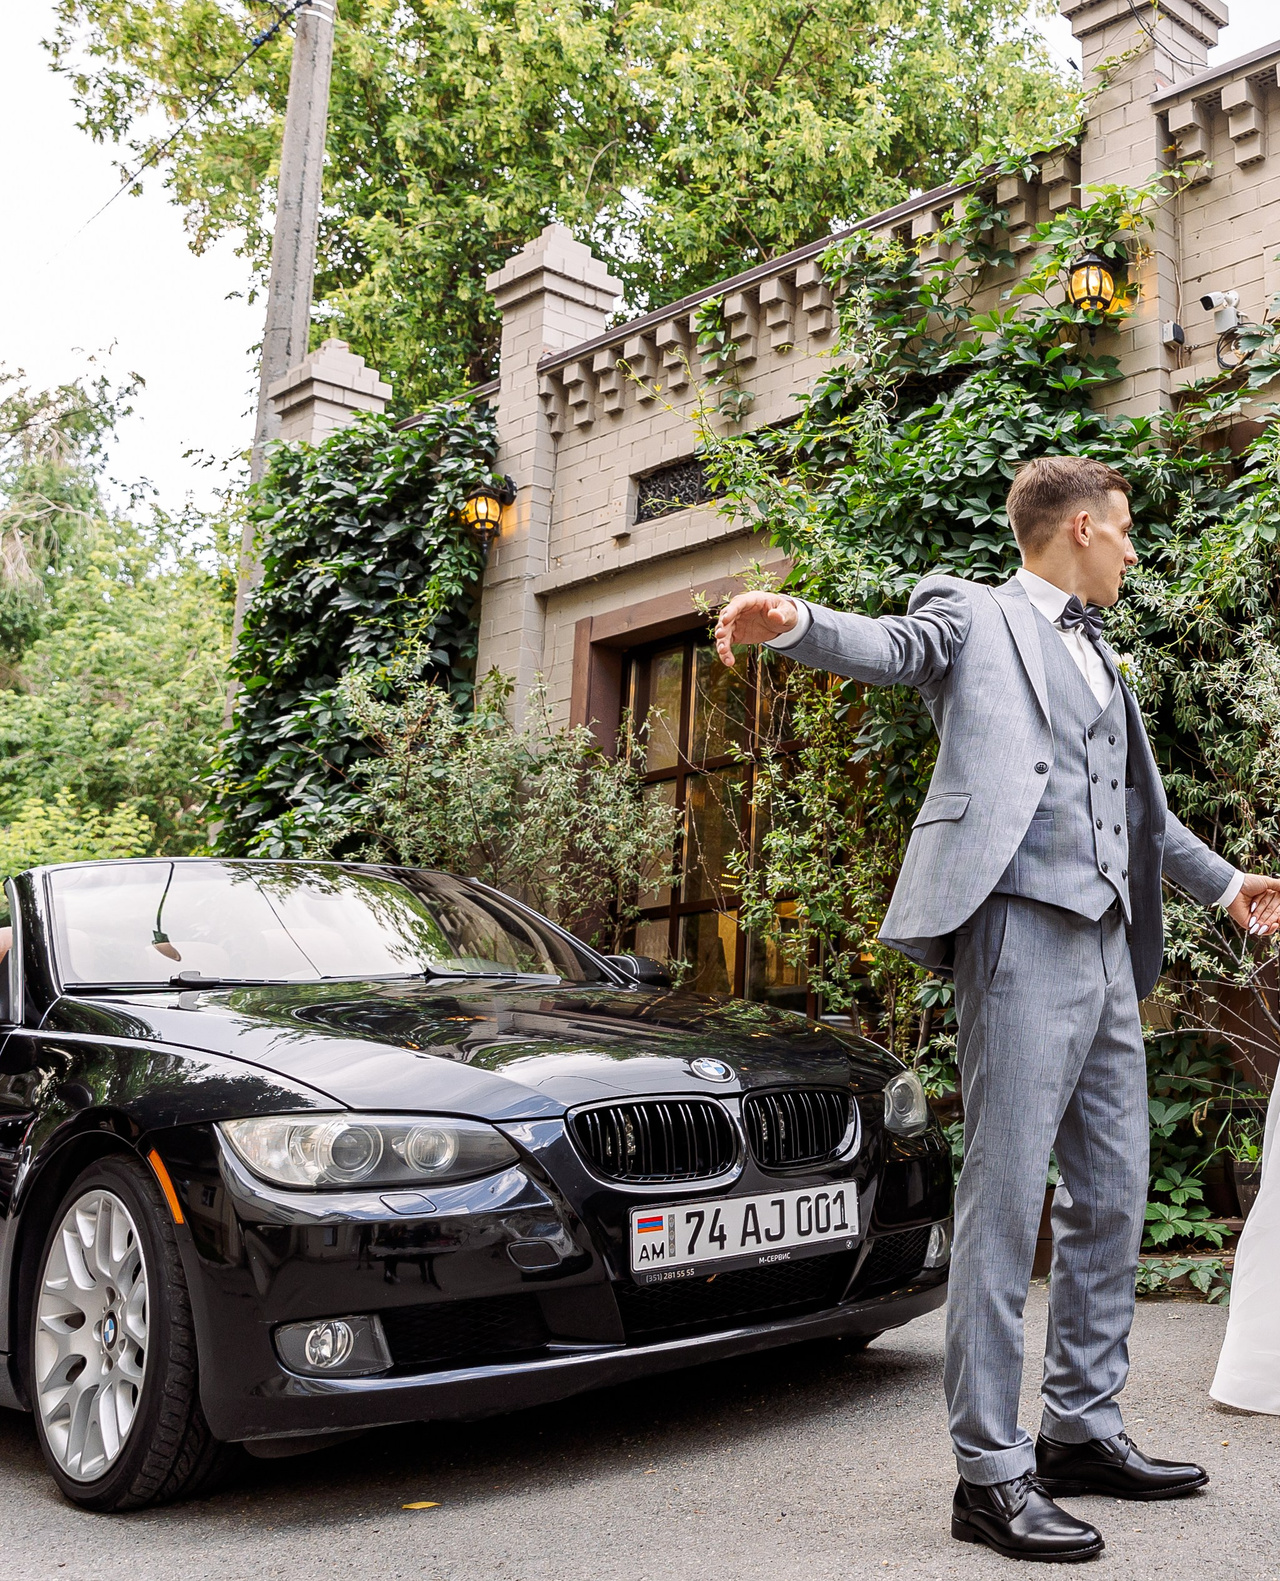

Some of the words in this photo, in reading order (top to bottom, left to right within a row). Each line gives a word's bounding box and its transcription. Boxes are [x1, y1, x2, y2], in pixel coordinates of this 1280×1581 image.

[685, 1208, 727, 1256] 74
[740, 1199, 785, 1247] AJ
[796, 1190, 849, 1237] 001
[639, 1242, 665, 1263] AM
[645, 1272, 663, 1283] (351)
[663, 1271, 676, 1280] 281
[676, 1269, 686, 1278] 55
[686, 1268, 695, 1277] 55
